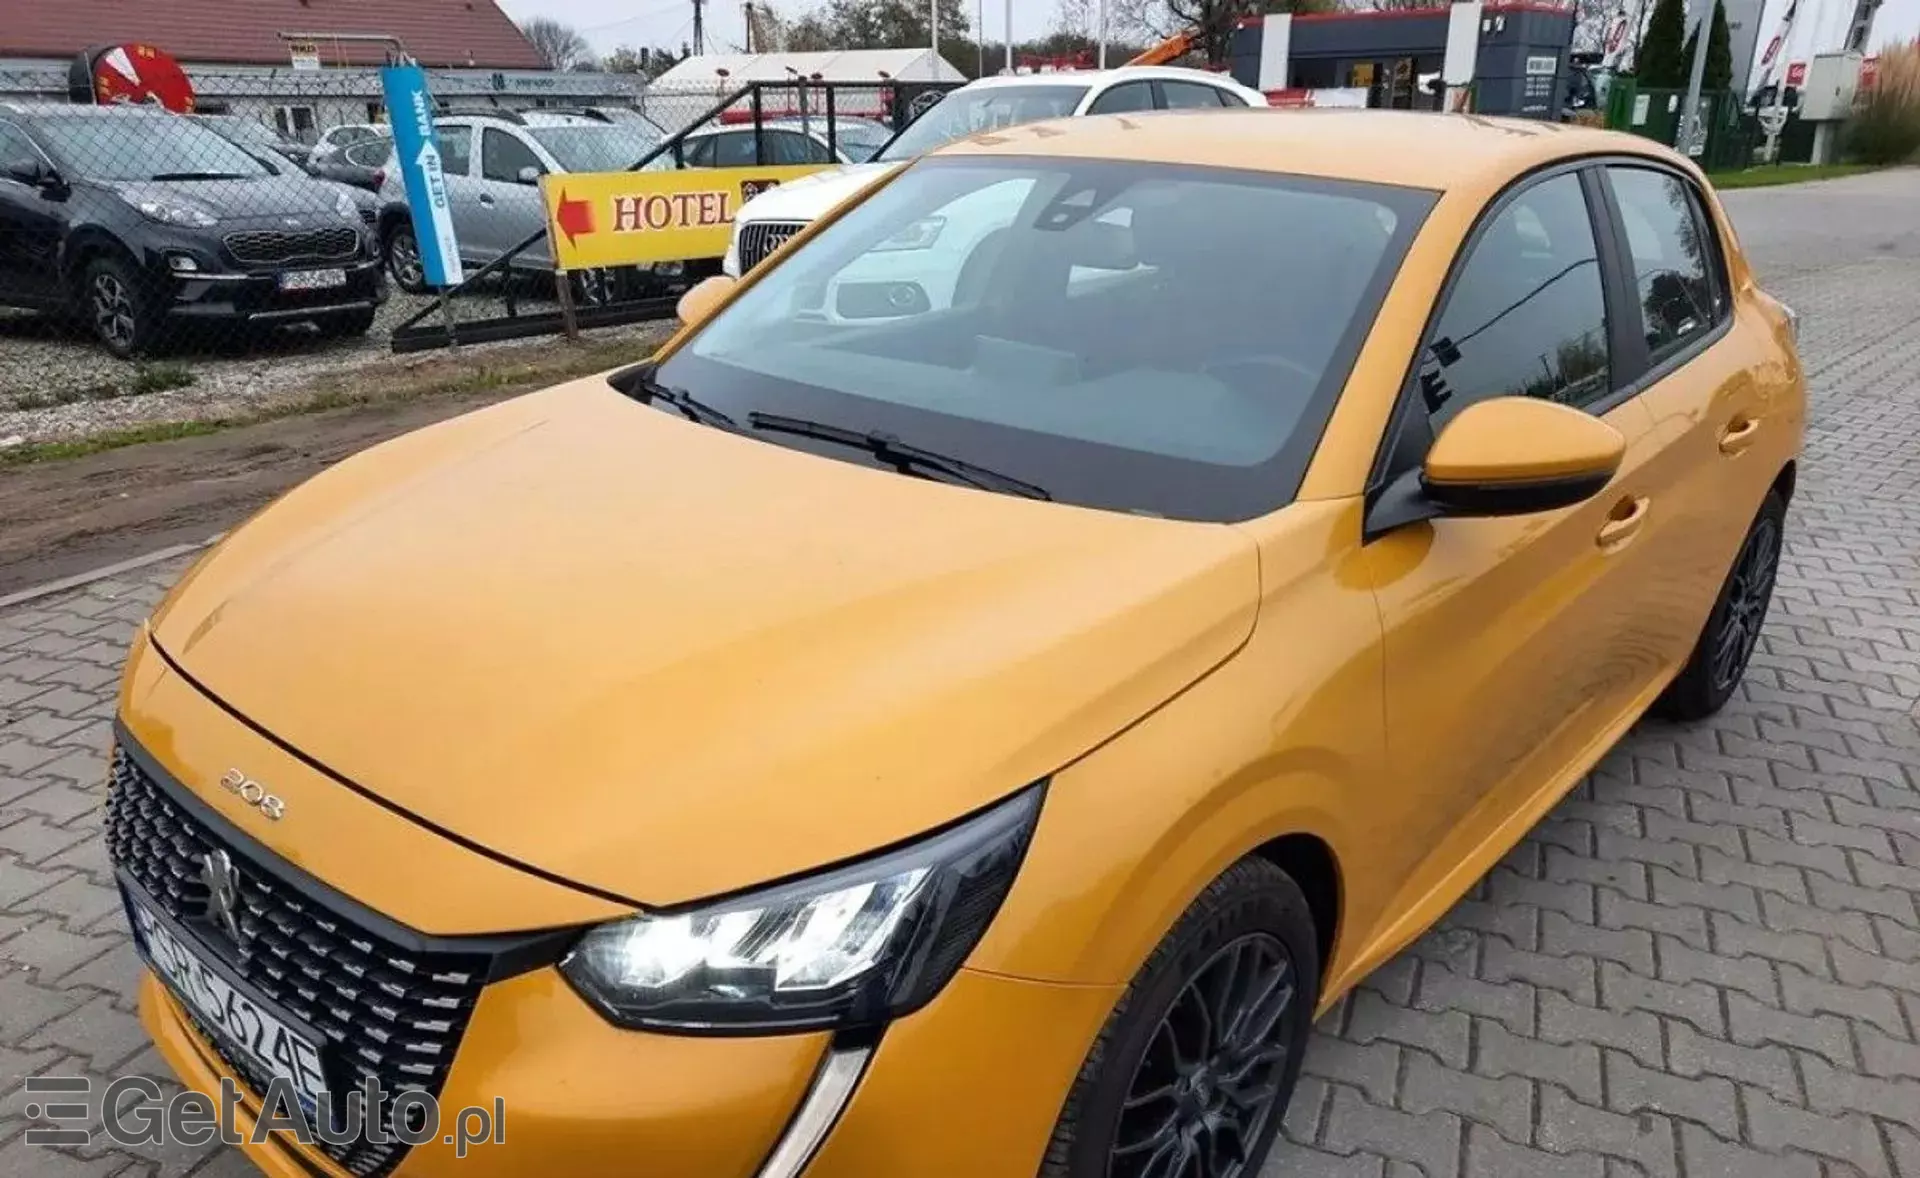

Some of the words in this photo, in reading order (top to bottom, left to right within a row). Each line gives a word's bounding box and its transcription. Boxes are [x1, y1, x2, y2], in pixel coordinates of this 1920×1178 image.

[411, 89, 431, 136] BANK
[426, 154, 439, 168] IN
[430, 174, 446, 209] GET
[613, 192, 735, 231] HOTEL
[218, 767, 285, 818] 208
